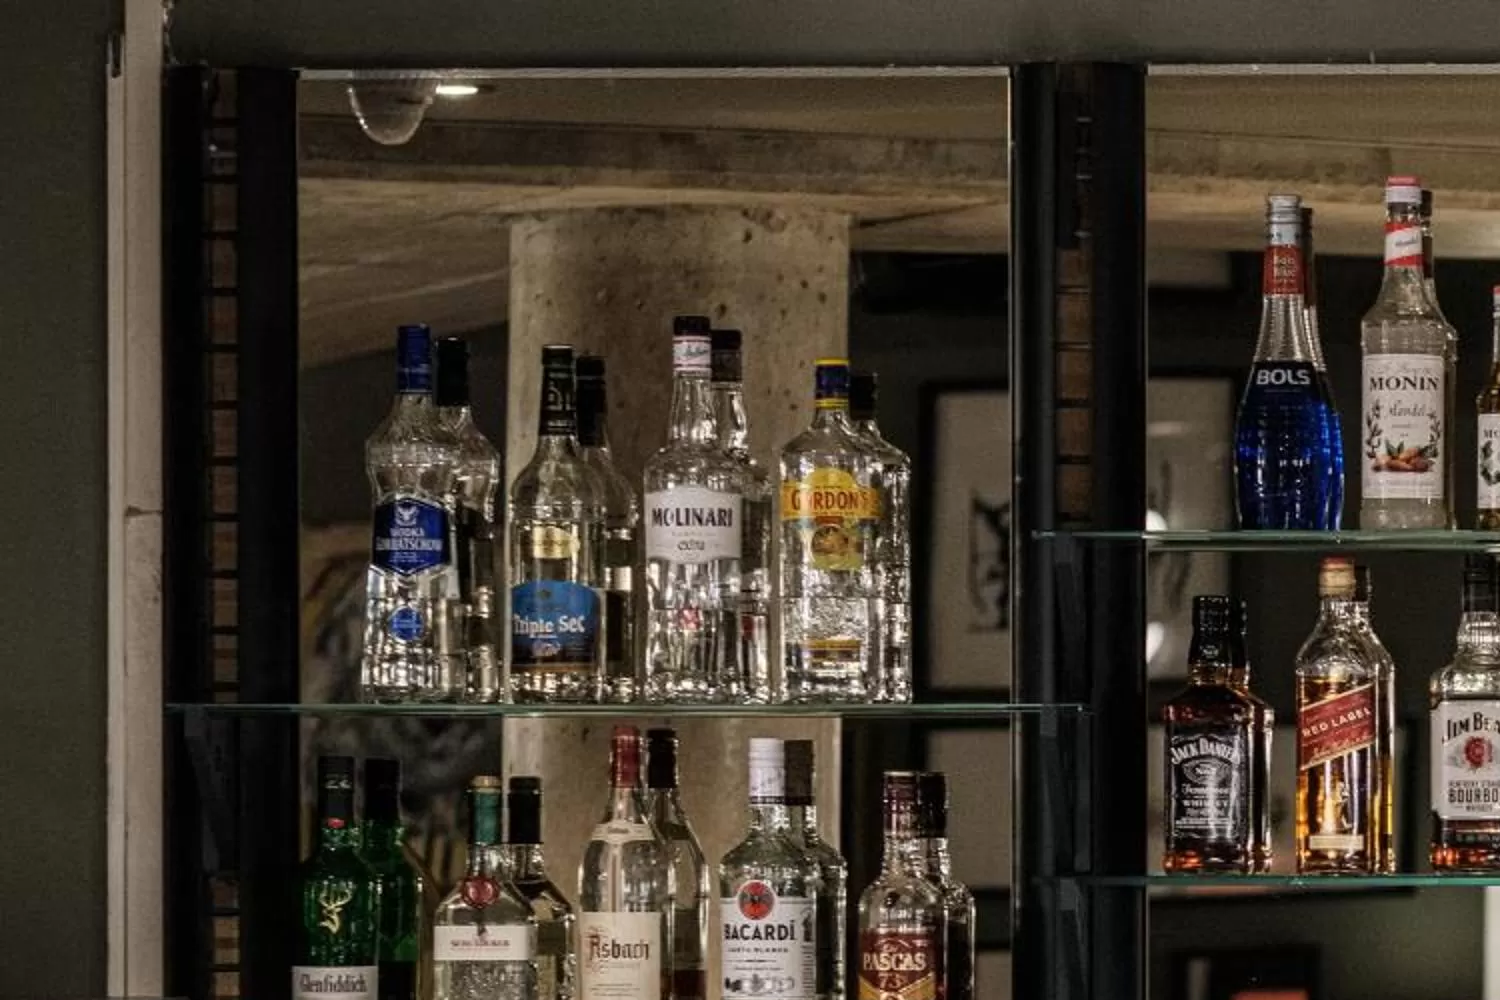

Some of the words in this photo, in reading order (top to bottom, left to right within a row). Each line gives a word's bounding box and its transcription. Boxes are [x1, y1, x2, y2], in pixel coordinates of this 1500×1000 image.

[1256, 368, 1311, 385] BOLS
[1369, 375, 1440, 391] MONIN
[791, 489, 870, 511] GRDON'S
[651, 507, 734, 528] MOLINARI
[512, 613, 555, 637] Triple
[557, 614, 586, 633] Sec
[1301, 721, 1329, 737] RED
[1331, 706, 1371, 728] LABEL
[1441, 717, 1470, 744] JIM
[1170, 743, 1200, 765] JACK
[1199, 737, 1240, 765] DANIE
[587, 931, 650, 961] Asbach
[862, 951, 927, 971] PASCAS
